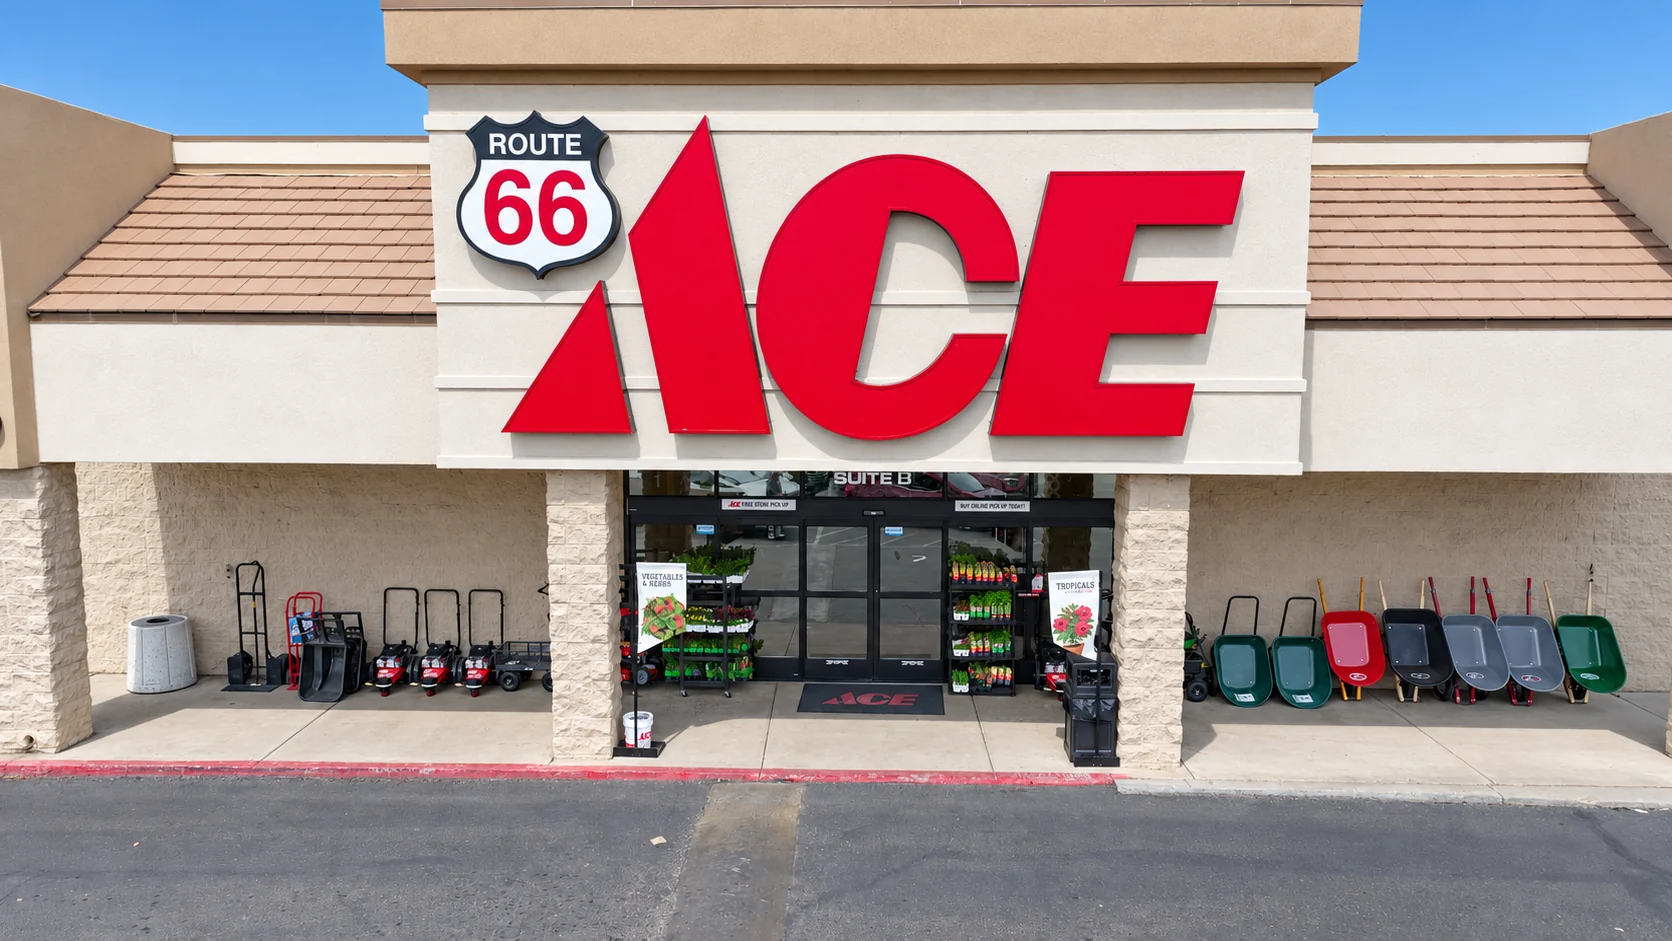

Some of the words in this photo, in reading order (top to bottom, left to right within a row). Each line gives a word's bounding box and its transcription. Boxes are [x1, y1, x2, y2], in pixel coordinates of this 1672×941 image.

[489, 133, 582, 156] ROUTE
[484, 168, 588, 246] 66
[501, 114, 1246, 441] ACE
[833, 471, 893, 485] SUITE
[897, 471, 912, 485] B
[1056, 581, 1095, 590] TROPICALS
[822, 692, 919, 706] ACE
